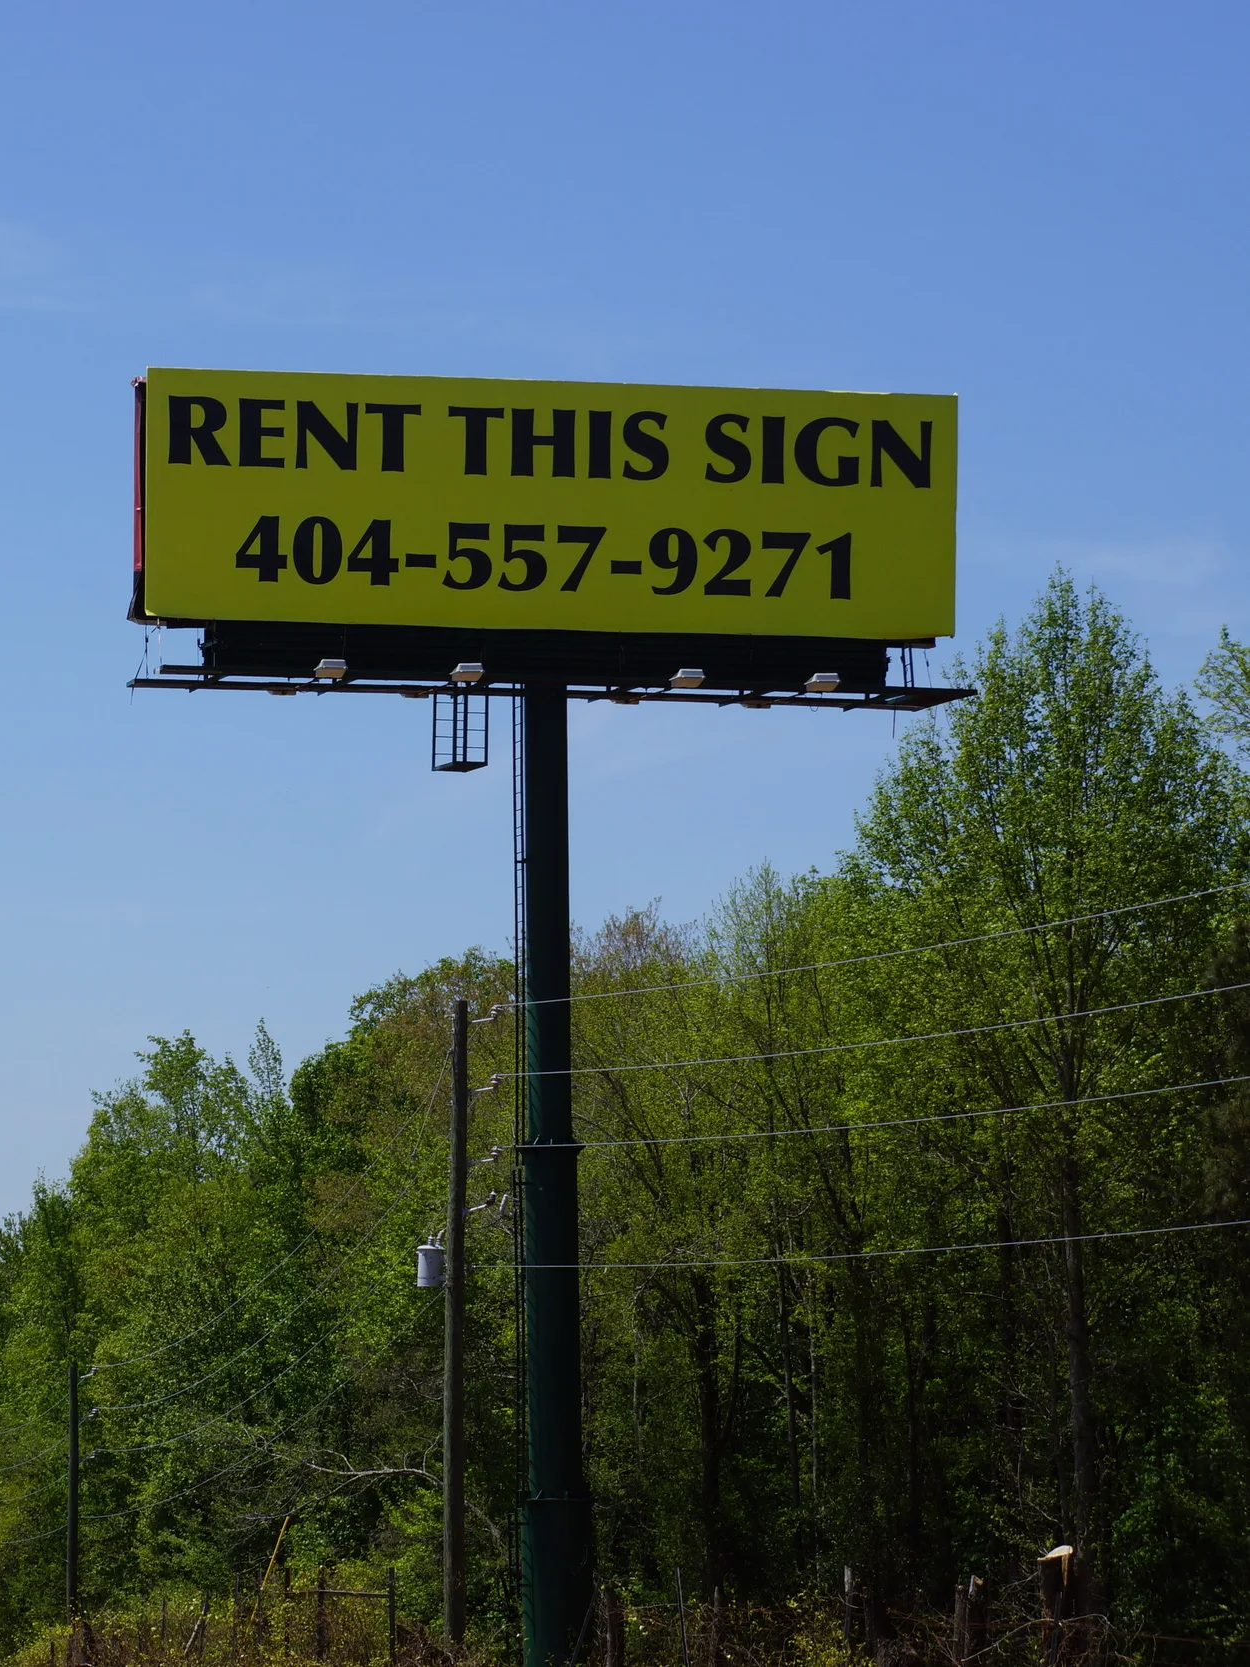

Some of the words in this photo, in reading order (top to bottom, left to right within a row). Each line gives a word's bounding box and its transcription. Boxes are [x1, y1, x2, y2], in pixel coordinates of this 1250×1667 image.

[167, 395, 422, 473] RENT
[447, 406, 670, 481] THIS
[704, 413, 934, 489] SIGN
[235, 515, 854, 601] 404-557-9271
